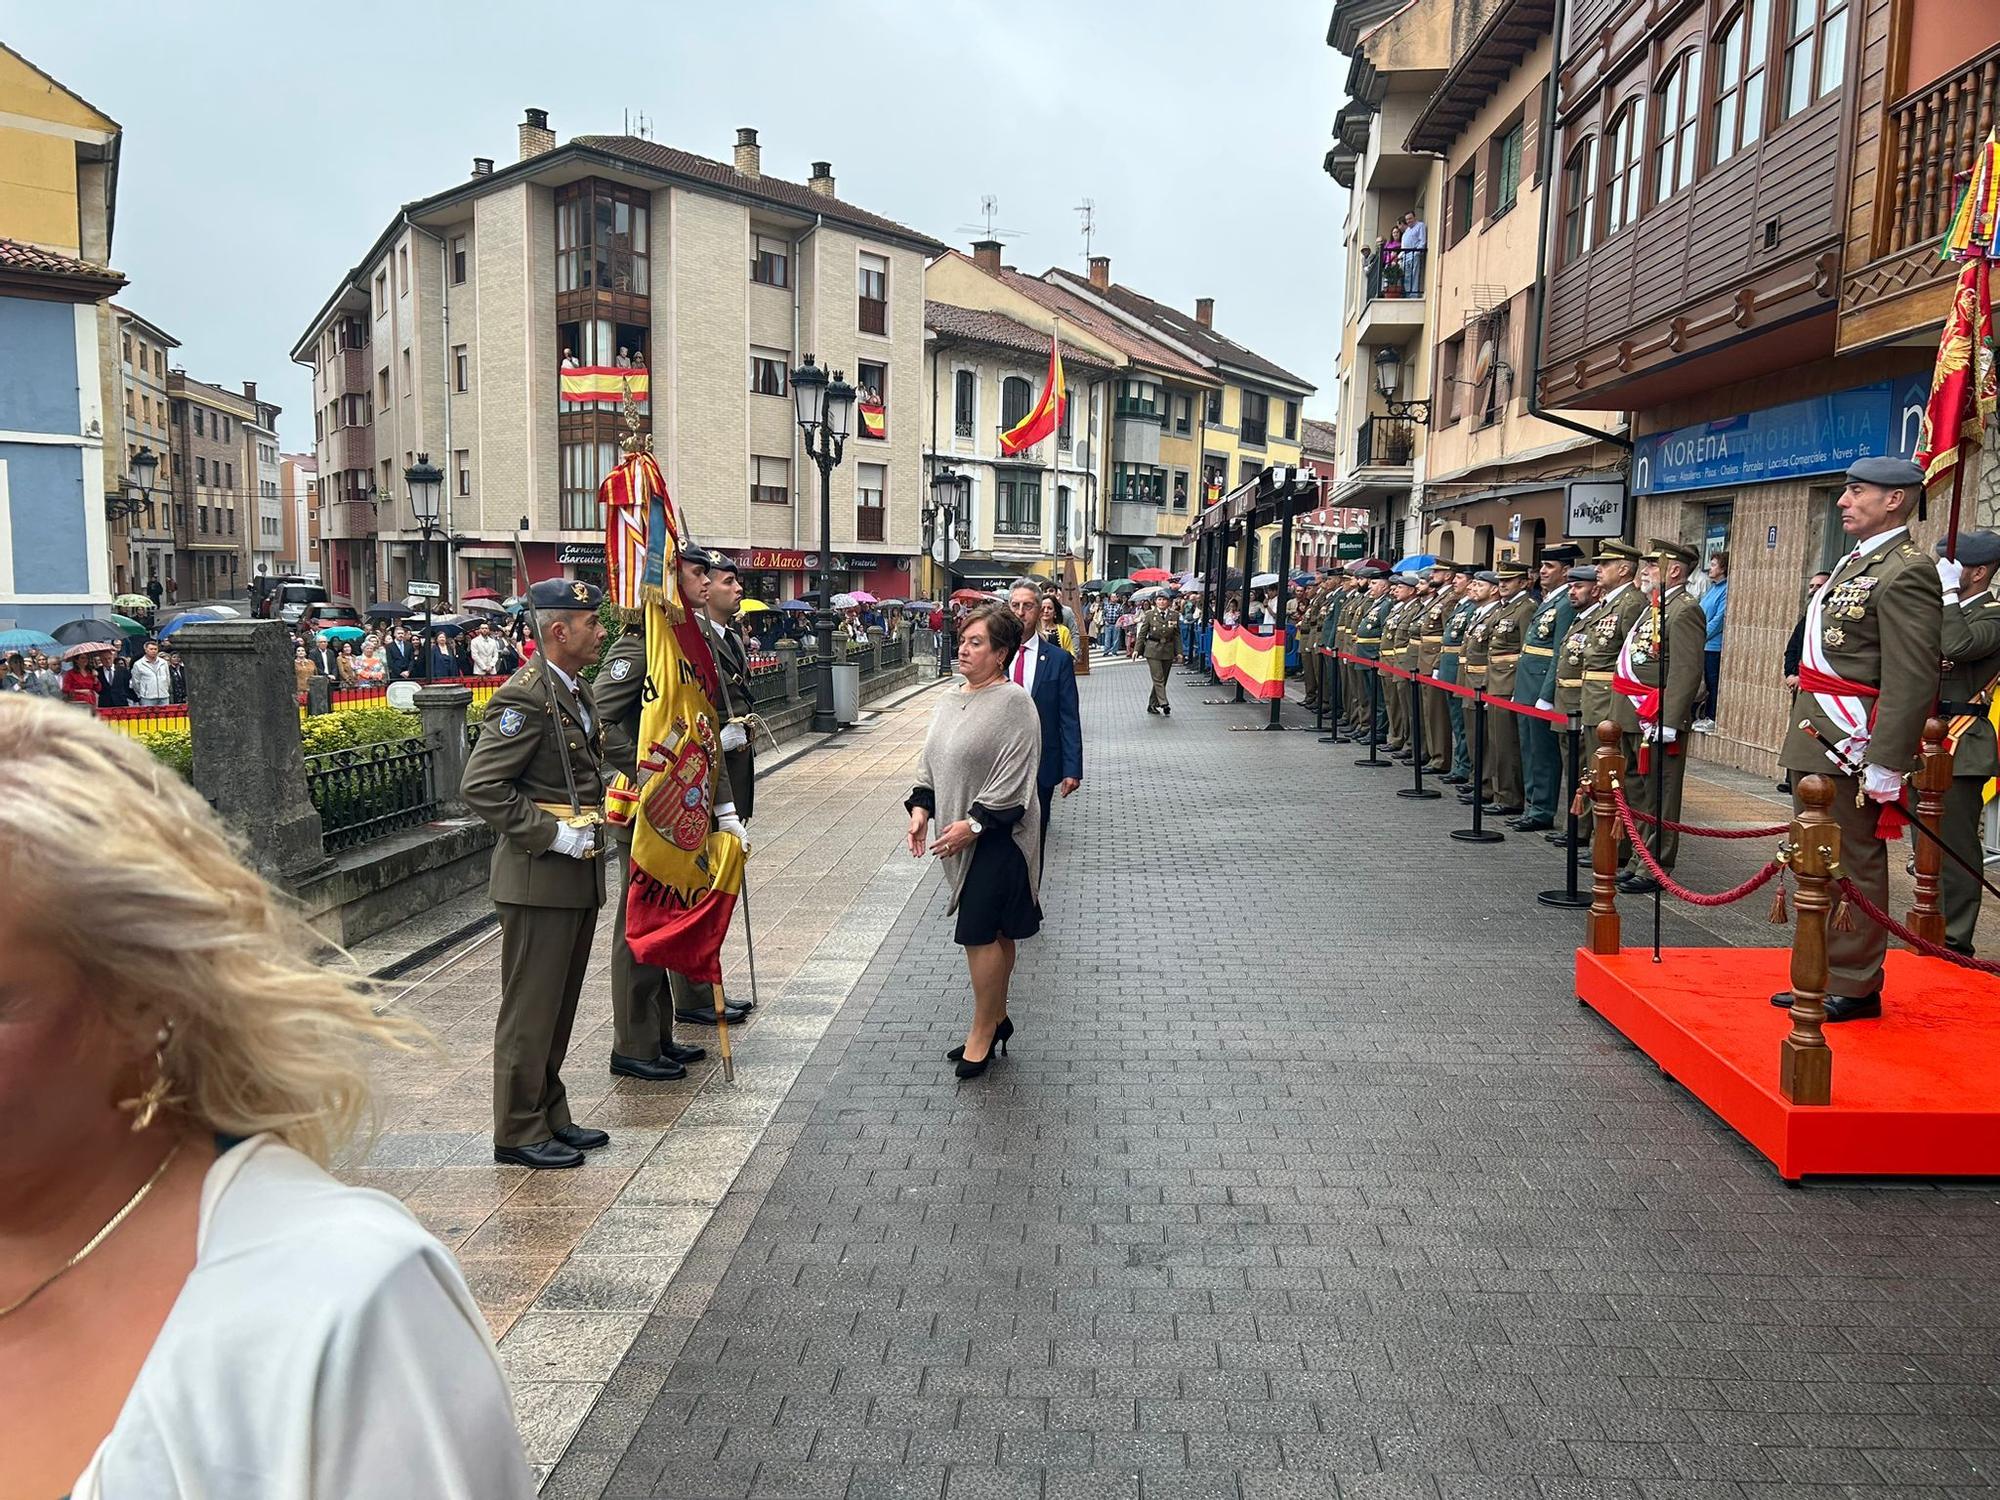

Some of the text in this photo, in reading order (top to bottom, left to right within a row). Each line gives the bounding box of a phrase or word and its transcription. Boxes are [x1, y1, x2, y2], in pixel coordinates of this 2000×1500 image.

[1732, 410, 1872, 454] INMOBILIARIA
[1742, 461, 1764, 473] Parcelas
[1768, 457, 1789, 469] Locales
[1790, 451, 1827, 467] Comerciales
[1832, 447, 1853, 460] Naves
[1859, 443, 1870, 456] Etc
[1573, 503, 1619, 518] HATCHET
[733, 553, 750, 567] ría
[753, 552, 766, 567] de
[768, 553, 803, 568] Marco
